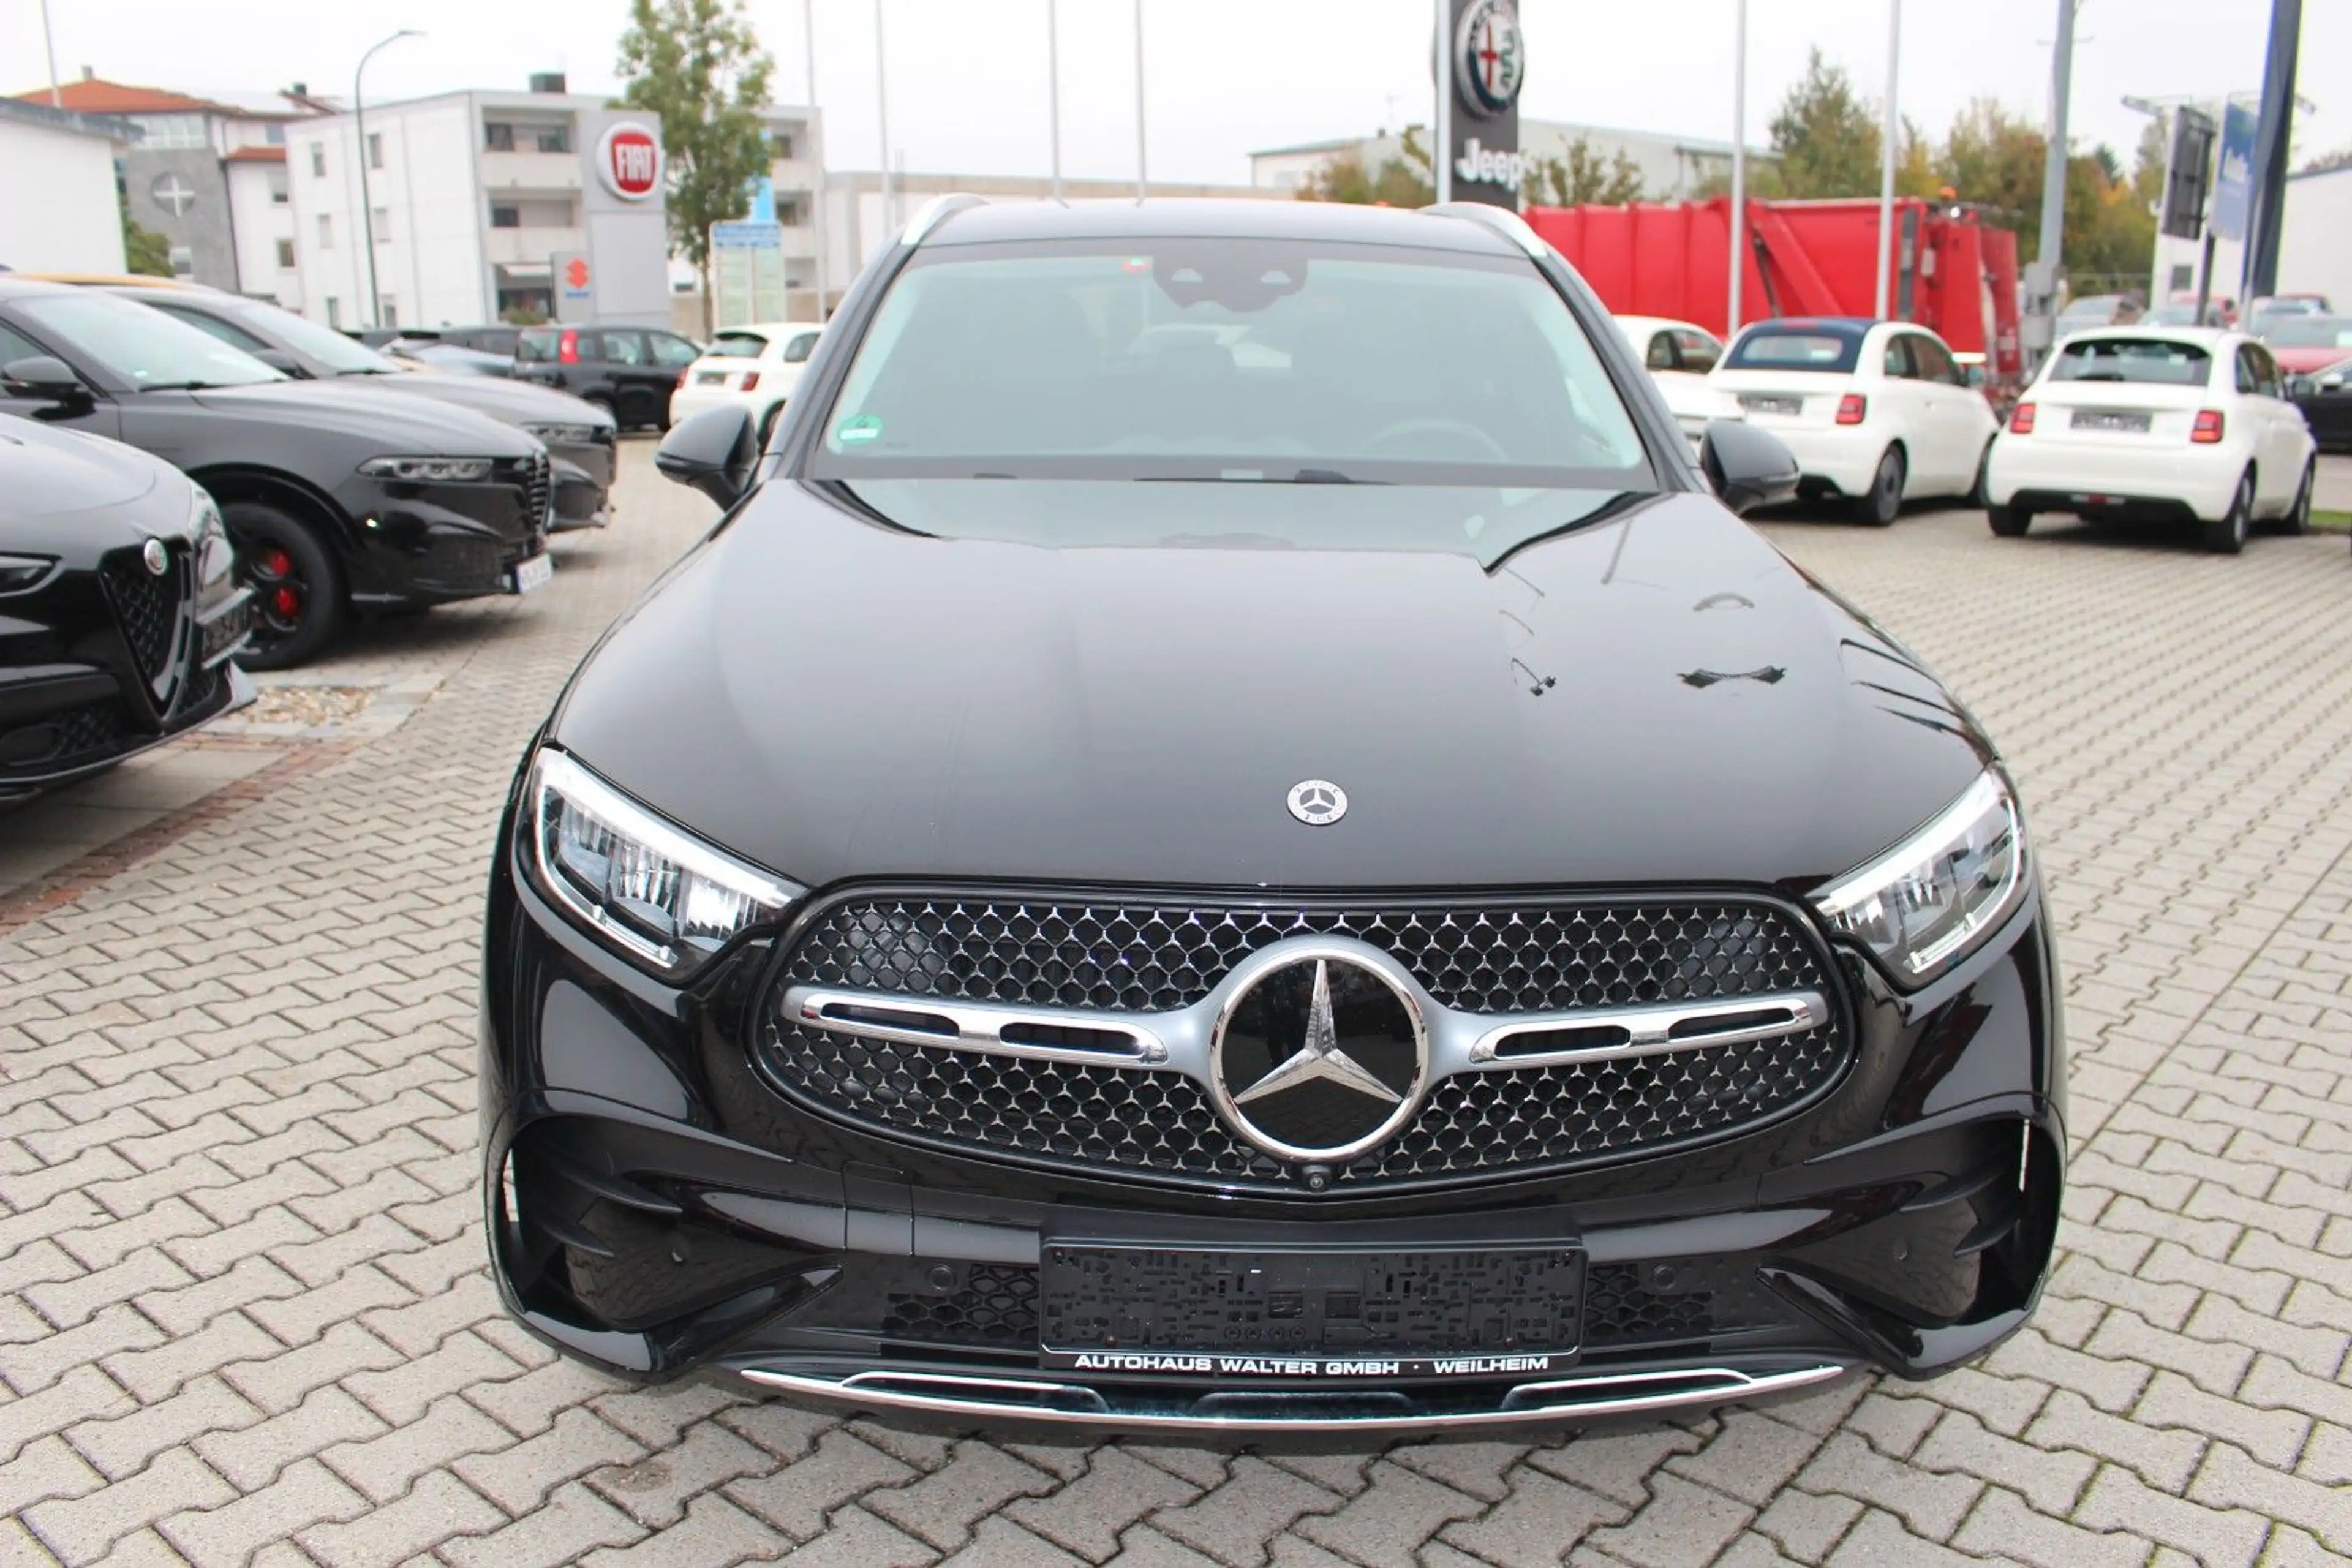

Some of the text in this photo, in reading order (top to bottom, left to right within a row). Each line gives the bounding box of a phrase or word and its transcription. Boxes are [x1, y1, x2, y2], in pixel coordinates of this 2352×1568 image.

[614, 143, 653, 183] FIAT
[1454, 137, 1522, 191] Jeep
[1074, 1354, 1549, 1376] AUTOHAUS WALTER GMBH WEILHEIM
